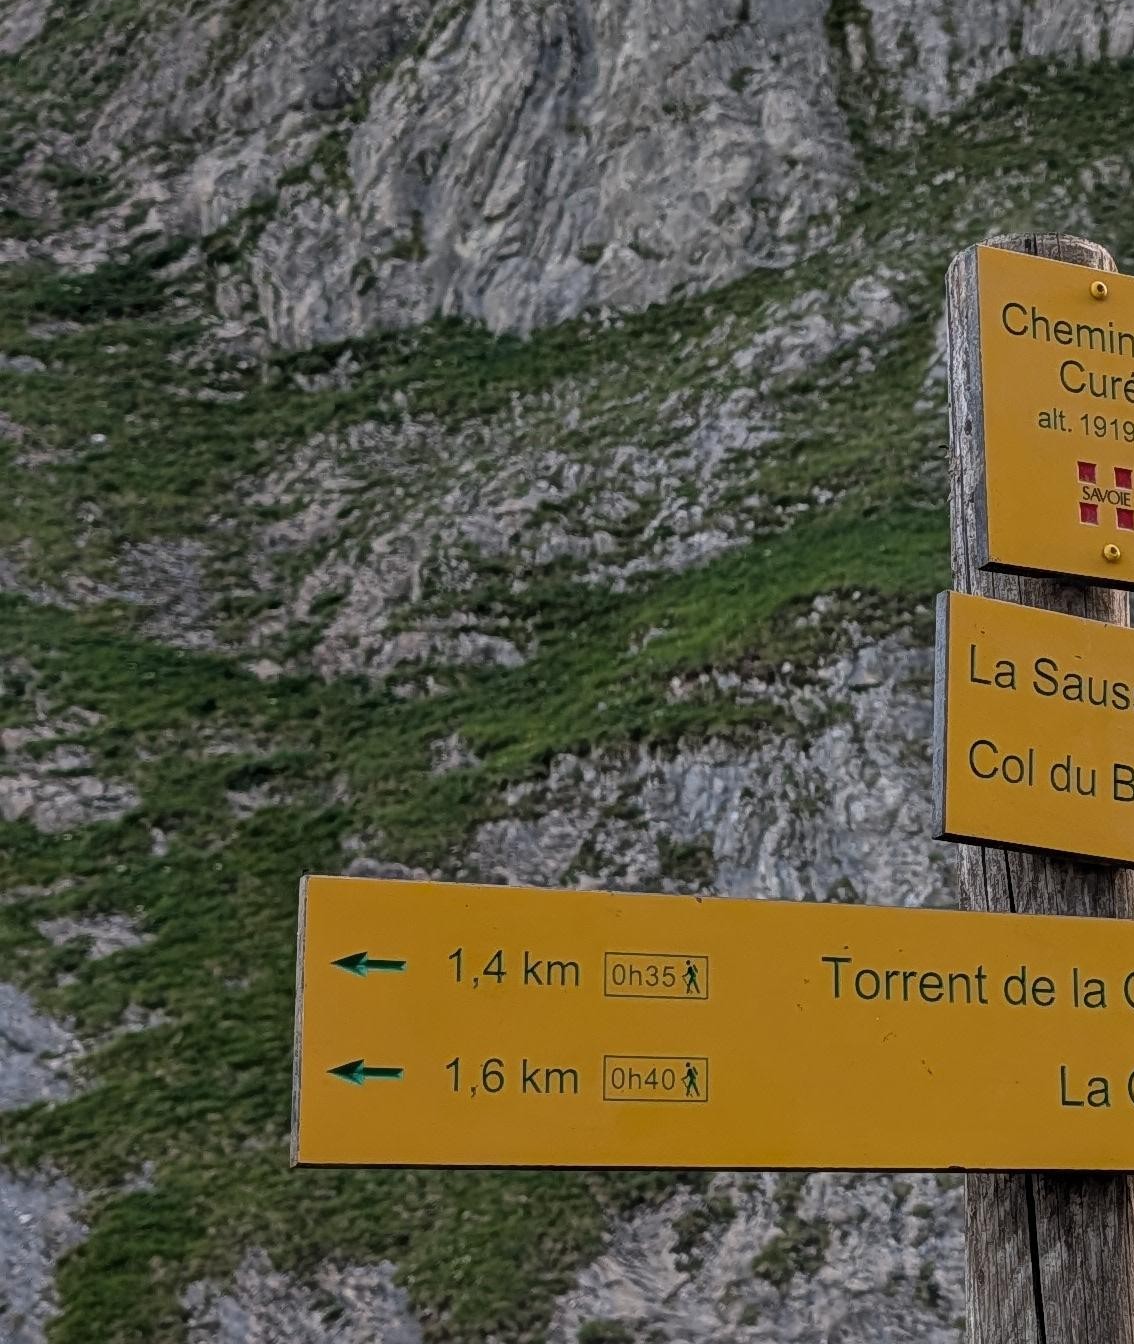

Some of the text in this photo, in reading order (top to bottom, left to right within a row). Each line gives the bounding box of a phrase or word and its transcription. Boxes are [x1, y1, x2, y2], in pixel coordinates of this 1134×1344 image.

[1038, 407, 1073, 433] alt.
[1082, 486, 1131, 506] SAVOIE
[970, 644, 1017, 691] La
[968, 739, 1034, 787] Col
[1050, 754, 1096, 797] du
[448, 947, 676, 989] 1,4 km 0h35
[821, 956, 989, 1005] Torrent
[1003, 965, 1056, 1007] de
[1072, 967, 1107, 1009] la
[446, 1057, 676, 1098] 1,6 km 0h40
[1060, 1065, 1111, 1108] La
